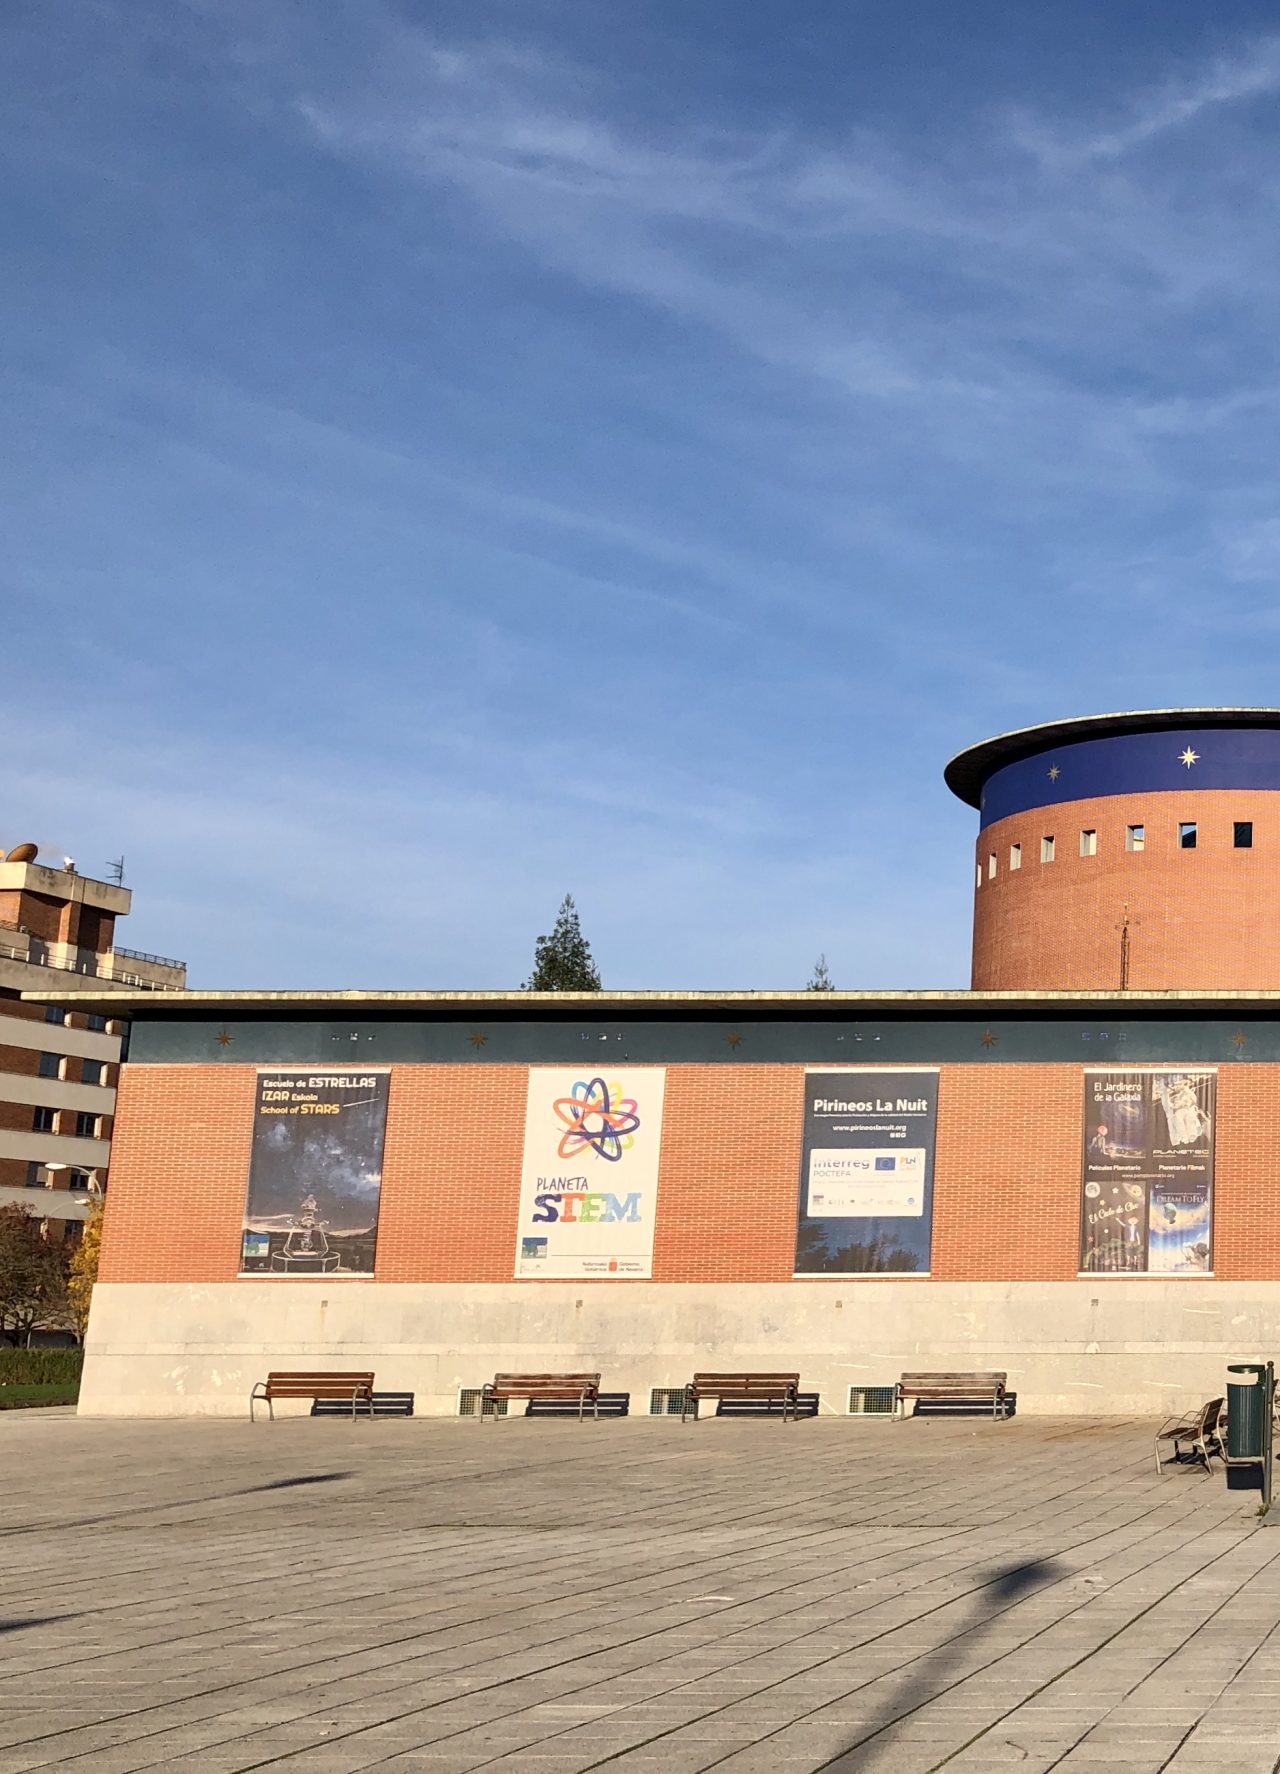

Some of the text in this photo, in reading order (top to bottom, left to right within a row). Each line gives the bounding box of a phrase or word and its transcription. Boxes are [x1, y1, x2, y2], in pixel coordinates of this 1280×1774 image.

[296, 1080, 307, 1088] de
[308, 1077, 377, 1088] ESTRELLAS
[1094, 1082, 1142, 1092] El Jardinero
[262, 1090, 290, 1101] IZAR
[1094, 1093, 1104, 1102] de
[1113, 1093, 1141, 1102] Galaxia
[260, 1103, 340, 1115] School of STARS
[813, 1098, 929, 1112] Pirineos La Nuit
[832, 1124, 907, 1132] www.pirineoslanuit.org
[536, 1176, 589, 1191] PLANETA
[532, 1192, 642, 1223] STEM
